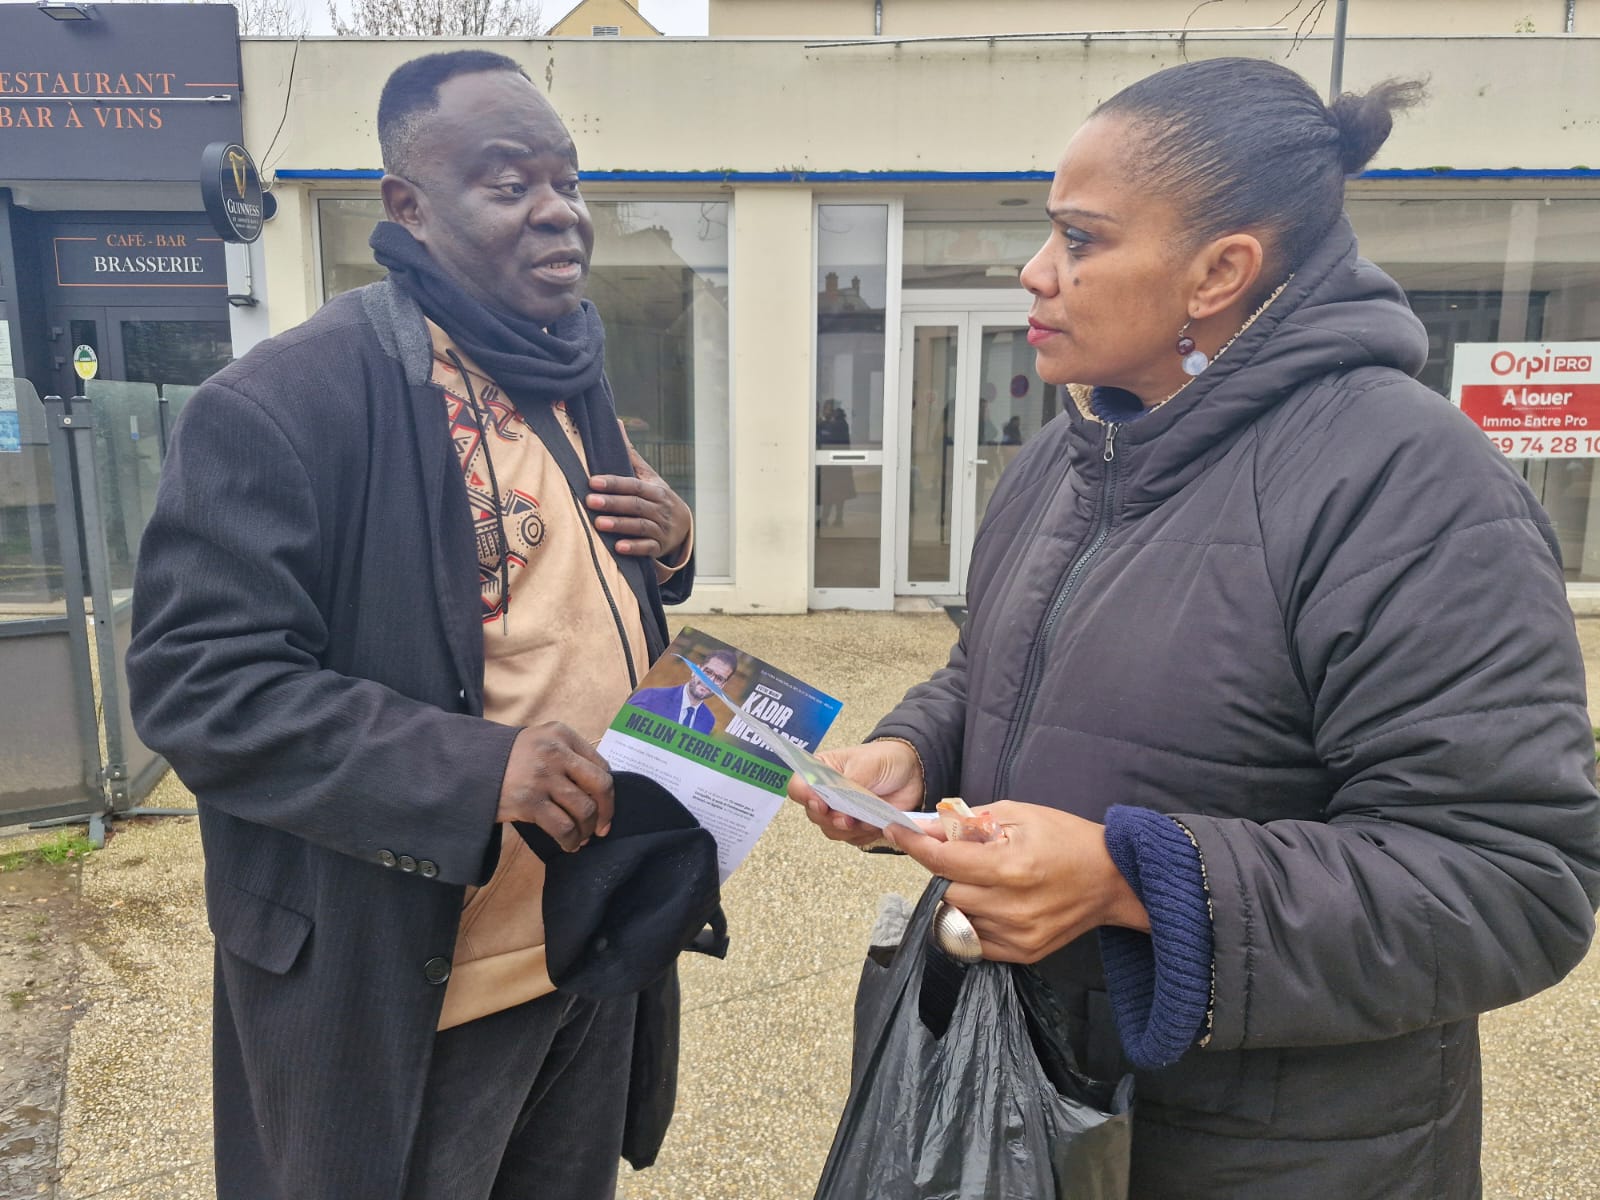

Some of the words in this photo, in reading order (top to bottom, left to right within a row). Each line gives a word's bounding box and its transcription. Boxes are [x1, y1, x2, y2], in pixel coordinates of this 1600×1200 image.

[0, 72, 176, 95] ESTAURANT
[0, 106, 55, 128] BAR
[65, 102, 84, 128] À
[92, 107, 163, 129] VINS
[227, 198, 260, 216] GUINNESS
[106, 231, 146, 247] CAFÉ
[156, 234, 187, 247] BAR
[94, 256, 204, 273] BRASSERIE
[1490, 349, 1552, 379] Orpi
[1555, 358, 1590, 370] PRO
[1502, 389, 1516, 406] A
[1521, 388, 1573, 406] louer
[1483, 415, 1521, 427] Immo
[1524, 415, 1561, 427] Entre
[1565, 415, 1588, 427] Pro
[1521, 437, 1543, 453] 74
[1551, 437, 1577, 453] 28
[741, 691, 793, 729] KADIR
[625, 712, 677, 744] MELUN
[677, 732, 722, 763] TERRE
[720, 751, 788, 789] D'AVENIRS
